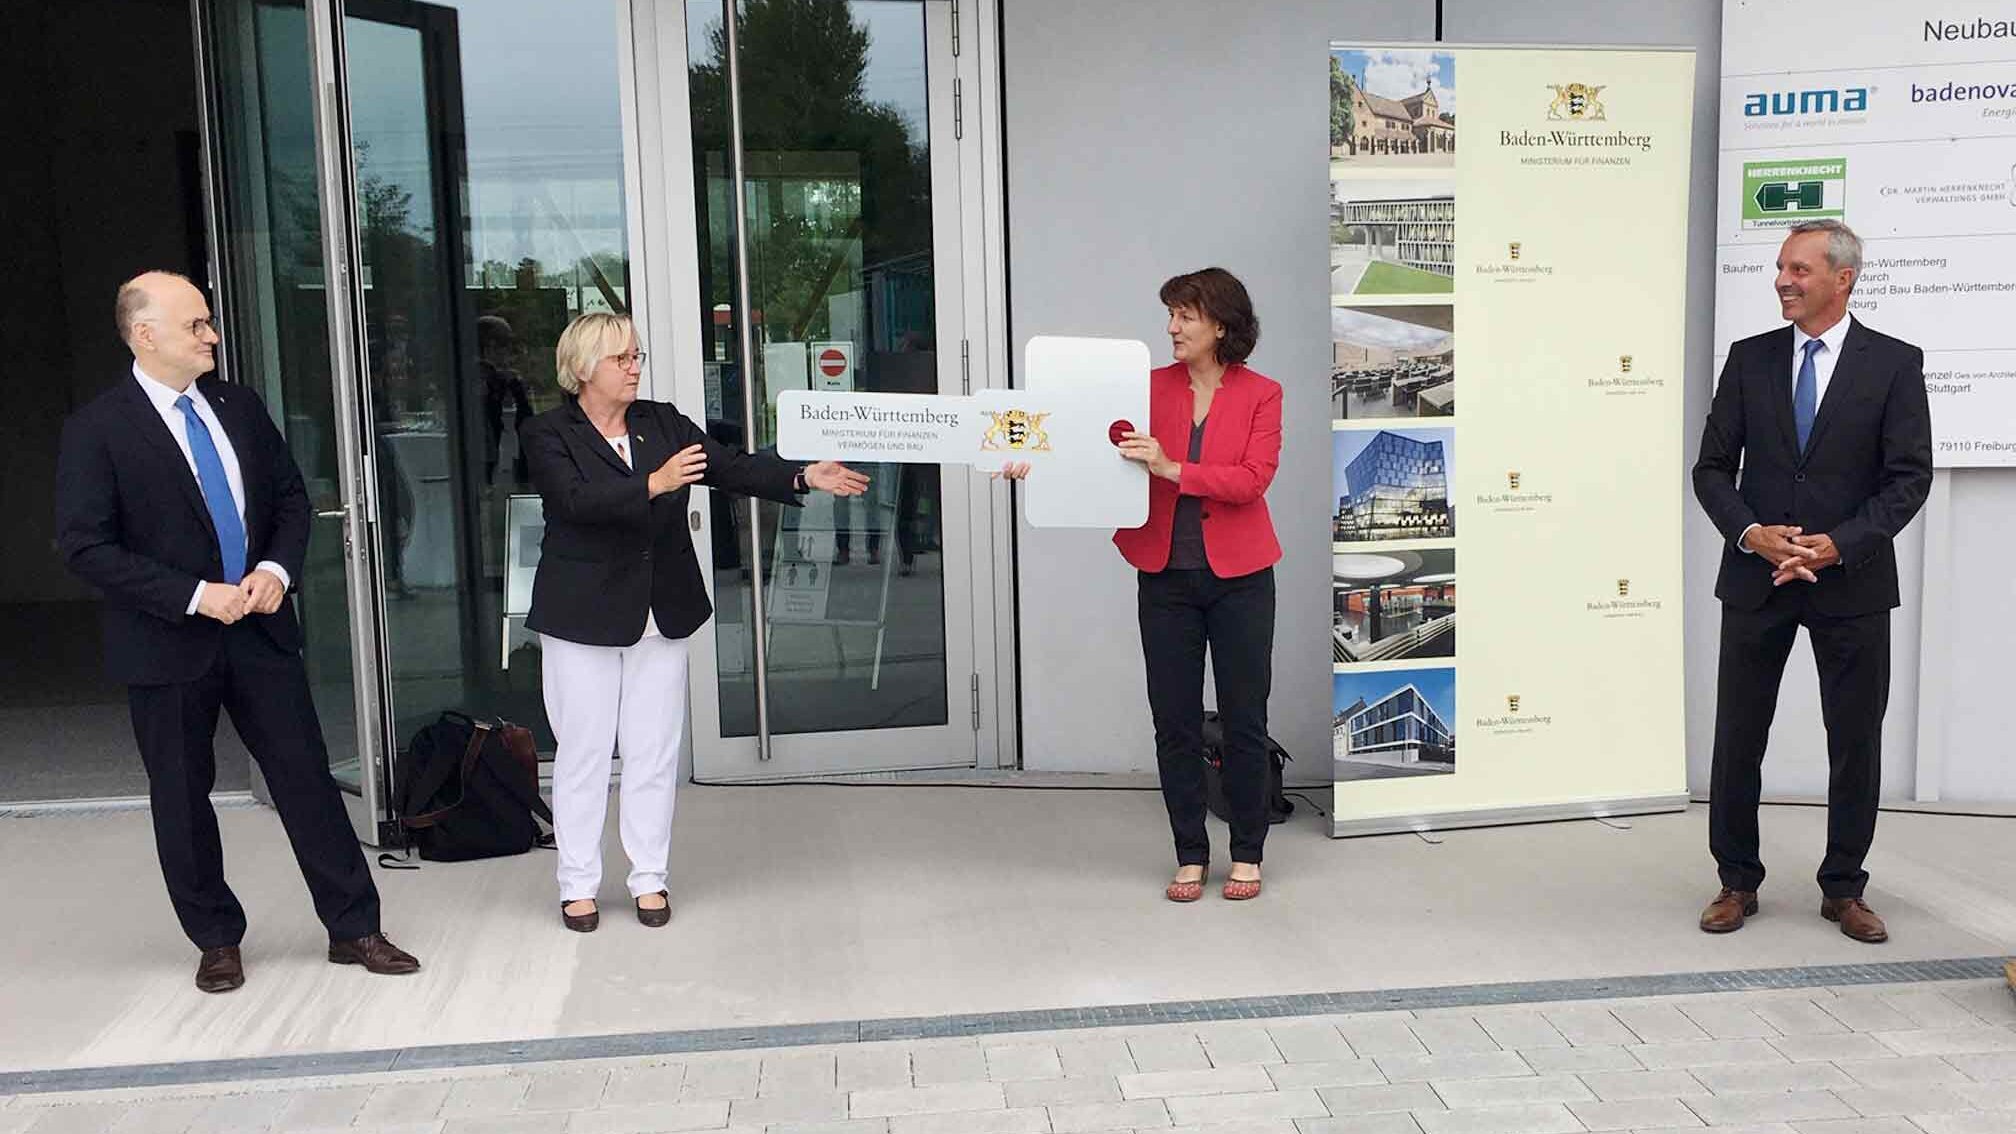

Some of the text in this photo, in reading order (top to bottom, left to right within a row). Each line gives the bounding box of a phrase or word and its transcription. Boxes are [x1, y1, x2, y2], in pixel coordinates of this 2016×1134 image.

[1911, 81, 2016, 103] badenova
[1744, 88, 1867, 117] auma
[1500, 129, 1651, 152] Baden-Württemberg
[1722, 263, 1764, 275] Bauherr
[1863, 257, 1948, 269] en-Württemberg
[1866, 285, 1887, 295] und
[1889, 284, 1911, 295] Bau
[1913, 282, 2016, 294] Baden-Württember
[1848, 299, 1878, 311] iburg
[1924, 371, 1953, 381] enzel
[1926, 383, 1971, 395] Stuttgart
[800, 404, 960, 428] Baden-Württemberg
[1939, 442, 1972, 452] 79110
